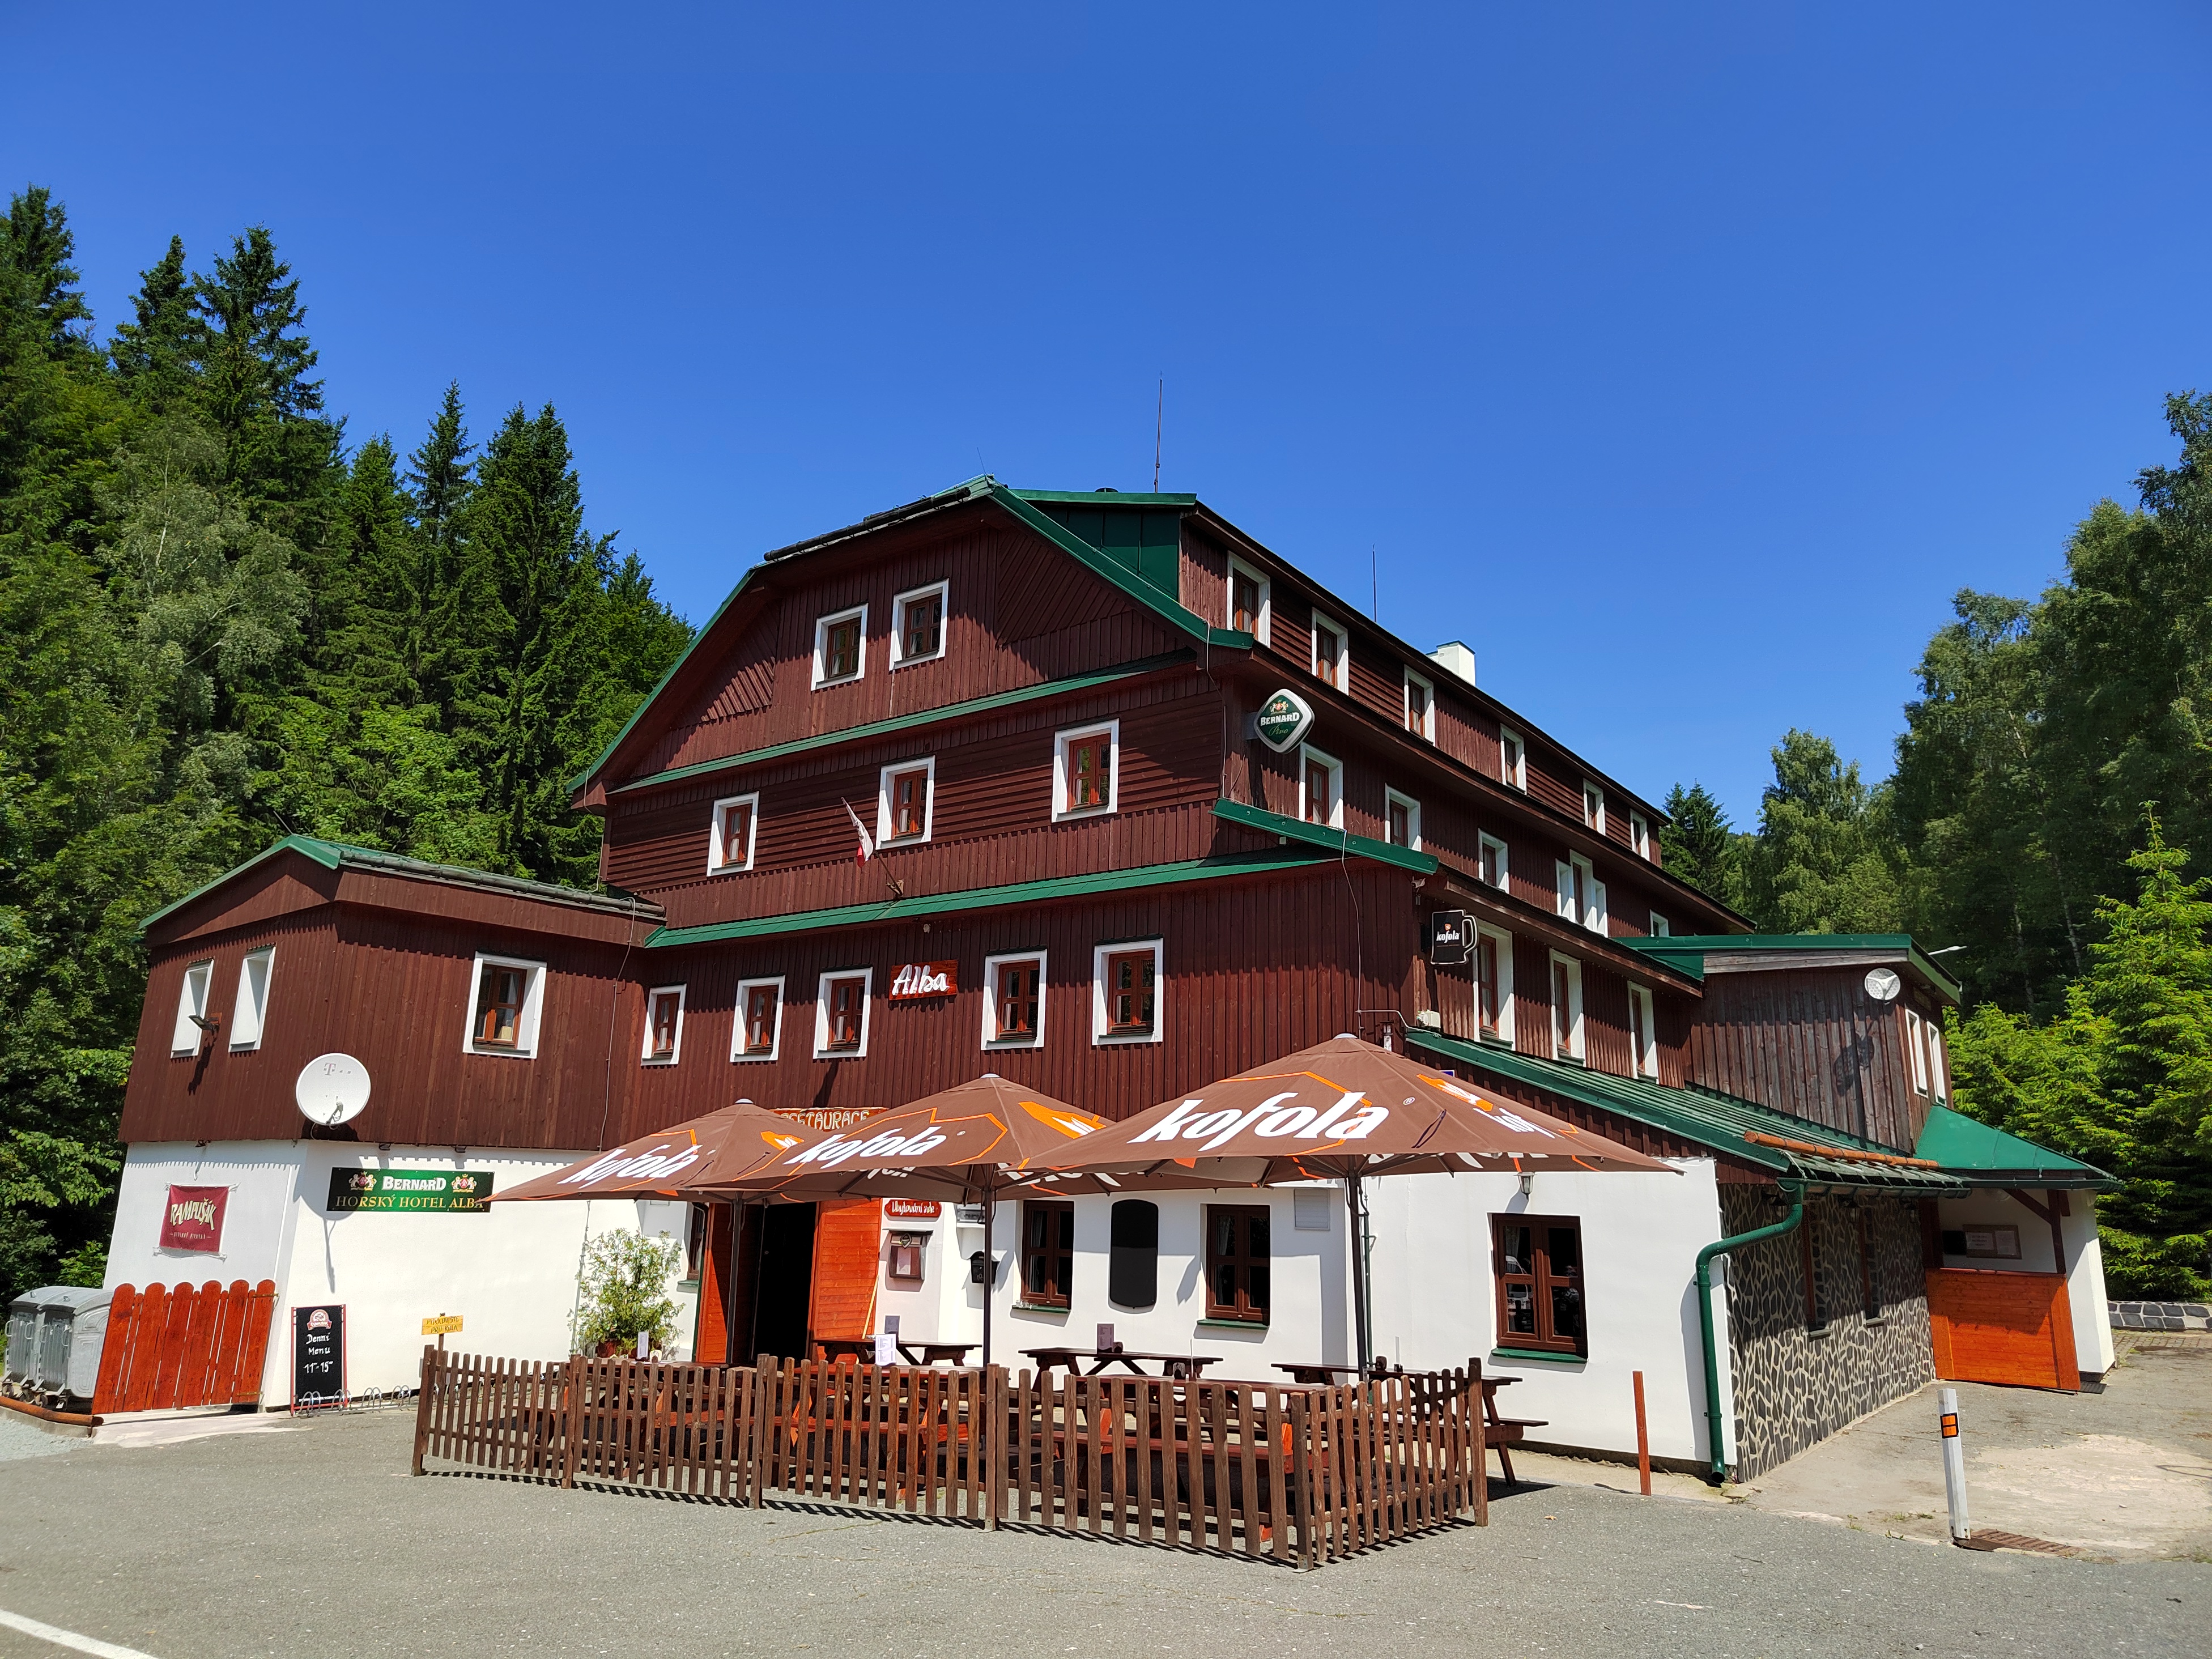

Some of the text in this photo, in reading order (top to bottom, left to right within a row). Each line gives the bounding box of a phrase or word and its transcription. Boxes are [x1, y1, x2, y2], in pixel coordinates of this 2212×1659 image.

[1260, 712, 1300, 727] BERNARD
[1269, 723, 1288, 736] Pivo
[1436, 930, 1460, 943] kofola
[892, 964, 950, 996] Alba
[1126, 1092, 1389, 1151] kofola
[782, 1126, 947, 1169] kofola
[556, 1144, 703, 1189] kofola
[382, 1176, 446, 1191] BERNARD
[335, 1193, 395, 1209] HORSKÝ
[398, 1197, 446, 1209] HOTEL
[170, 1197, 216, 1231] RAMPUŠÁK
[306, 1332, 331, 1345] Denní
[308, 1346, 331, 1355] Menu
